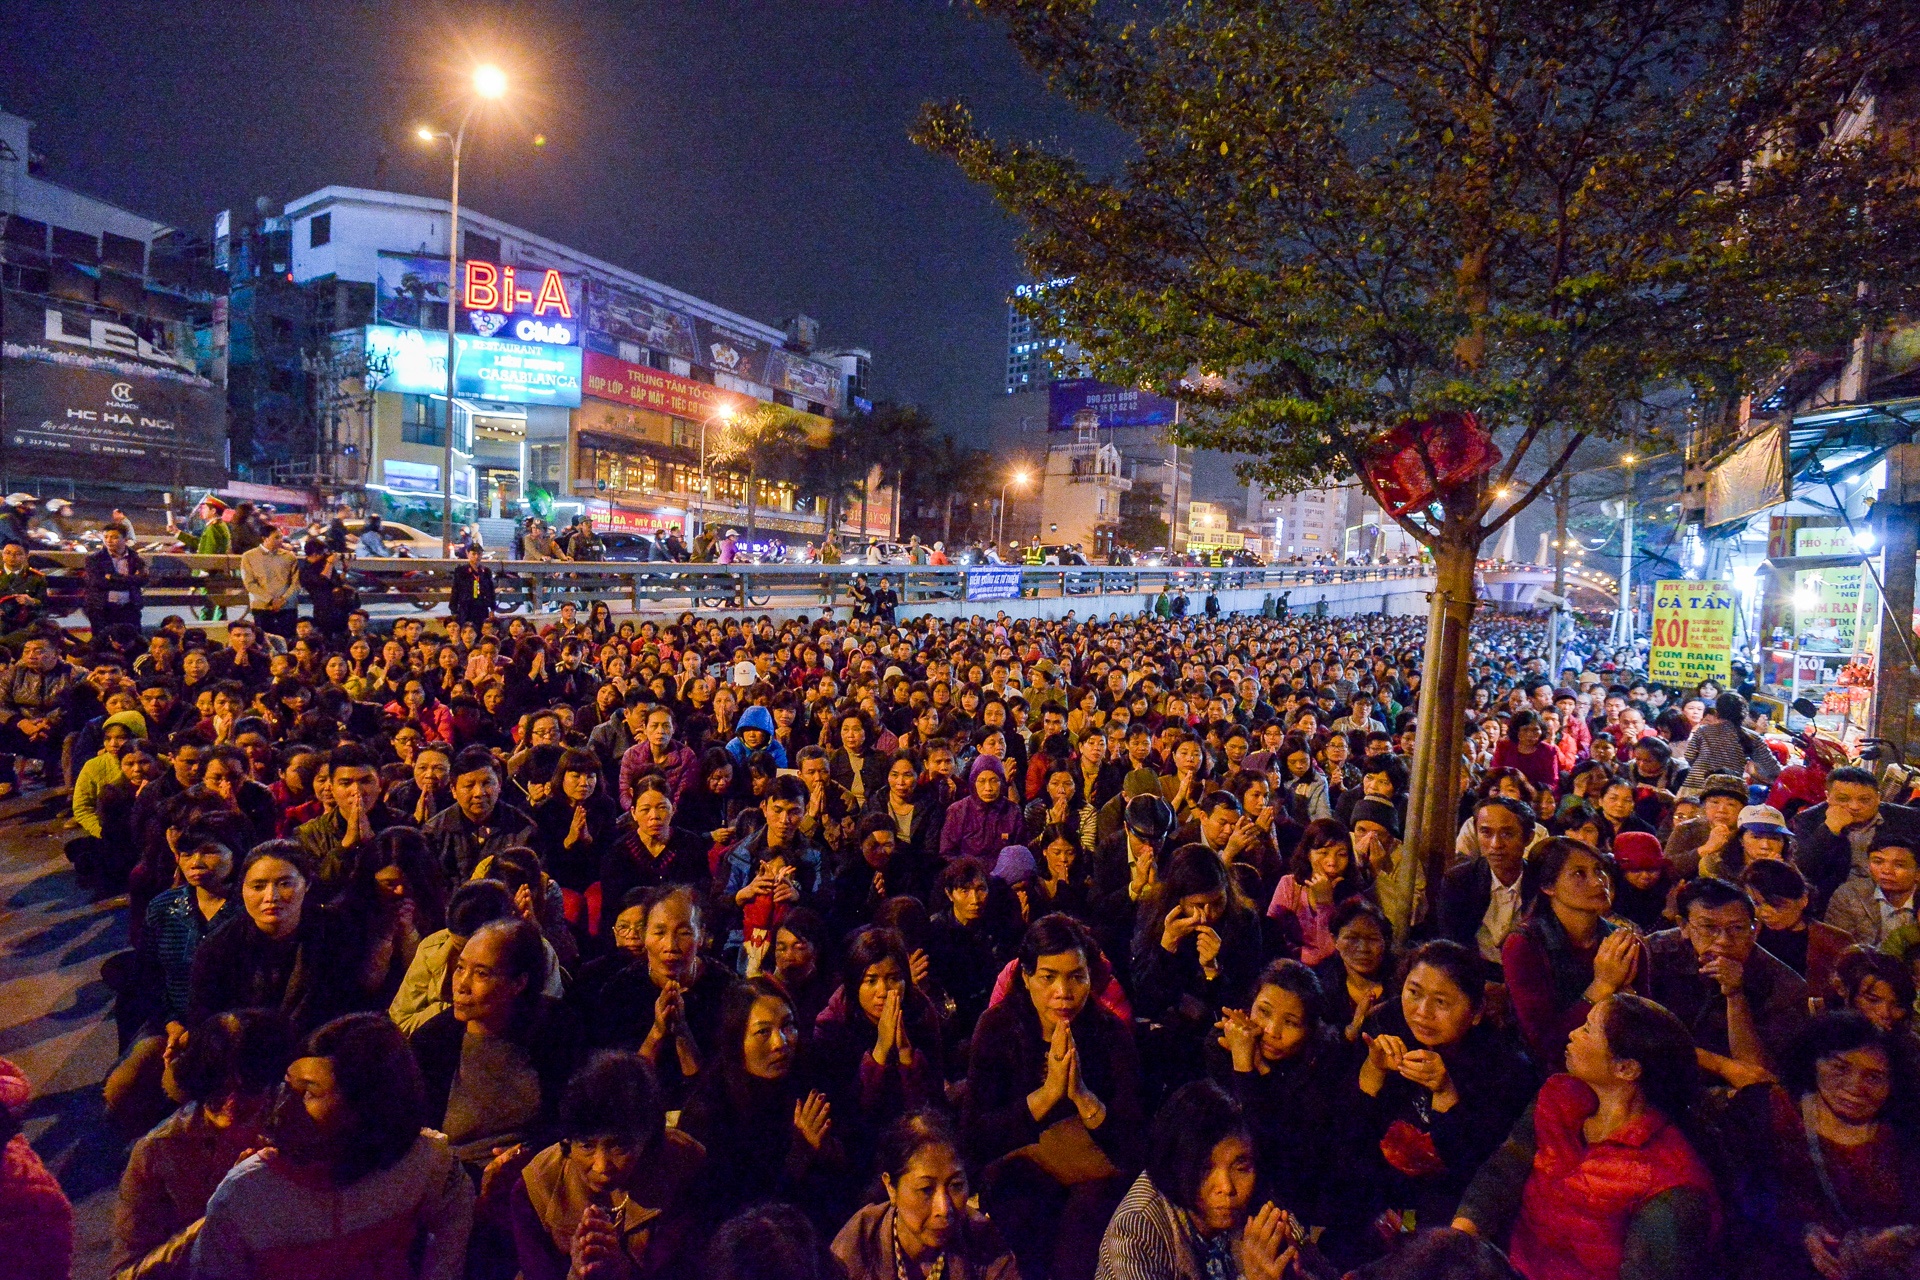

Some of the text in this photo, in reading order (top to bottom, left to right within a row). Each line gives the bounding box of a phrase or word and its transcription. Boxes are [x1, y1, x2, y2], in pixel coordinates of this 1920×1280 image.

[464, 260, 572, 318] Bi-A
[516, 320, 571, 345] Club
[472, 340, 543, 356] RESTAURANT
[478, 368, 578, 389] CASABLANCA
[628, 369, 664, 389] TRUNG
[67, 408, 97, 421] HC
[1657, 592, 1732, 609] GÀ TẦN
[1653, 609, 1690, 648] XÔI
[1687, 652, 1724, 662] RANG
